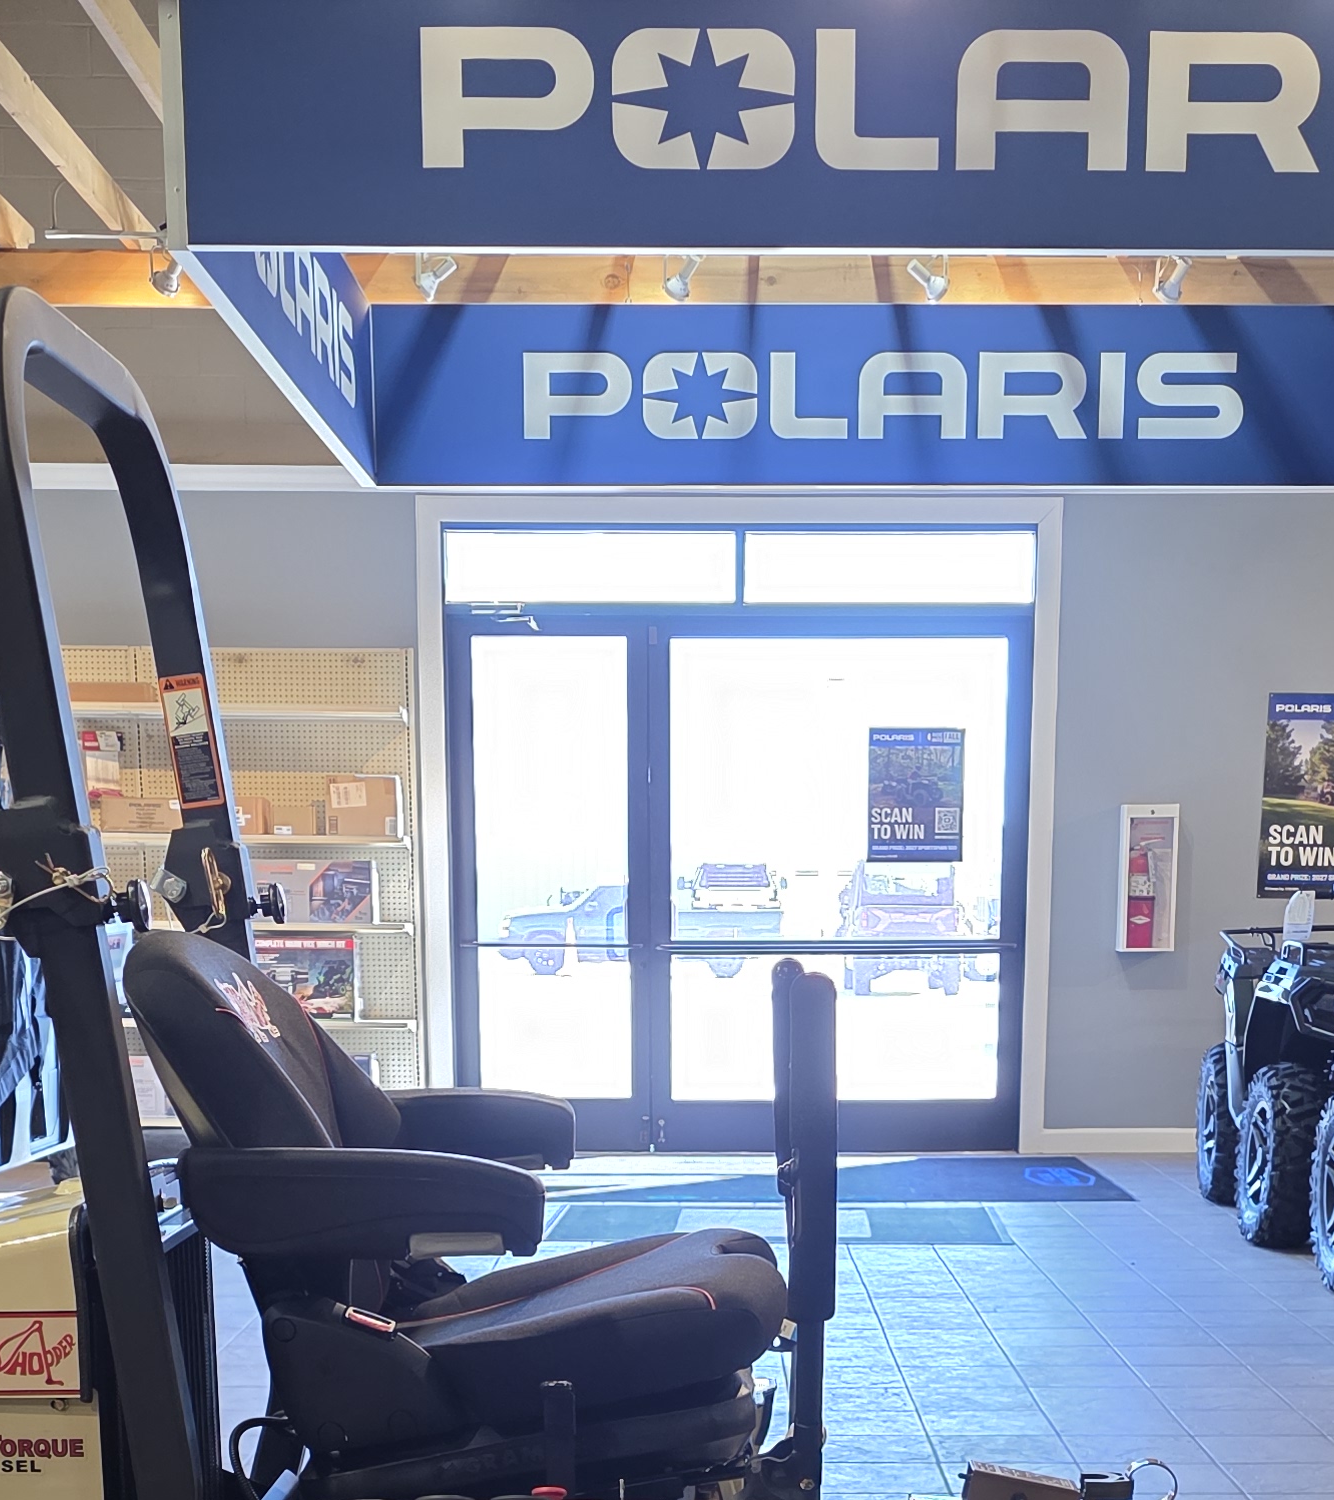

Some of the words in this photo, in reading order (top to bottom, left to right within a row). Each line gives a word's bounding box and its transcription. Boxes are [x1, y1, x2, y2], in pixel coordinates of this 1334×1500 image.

[522, 350, 1245, 440] POLARIS
[1275, 704, 1332, 713] POLARIS
[870, 807, 913, 823] SCAN
[870, 824, 891, 840] TO
[894, 824, 925, 840] WIN
[1268, 824, 1324, 845] SCAN
[1267, 846, 1294, 866] TO
